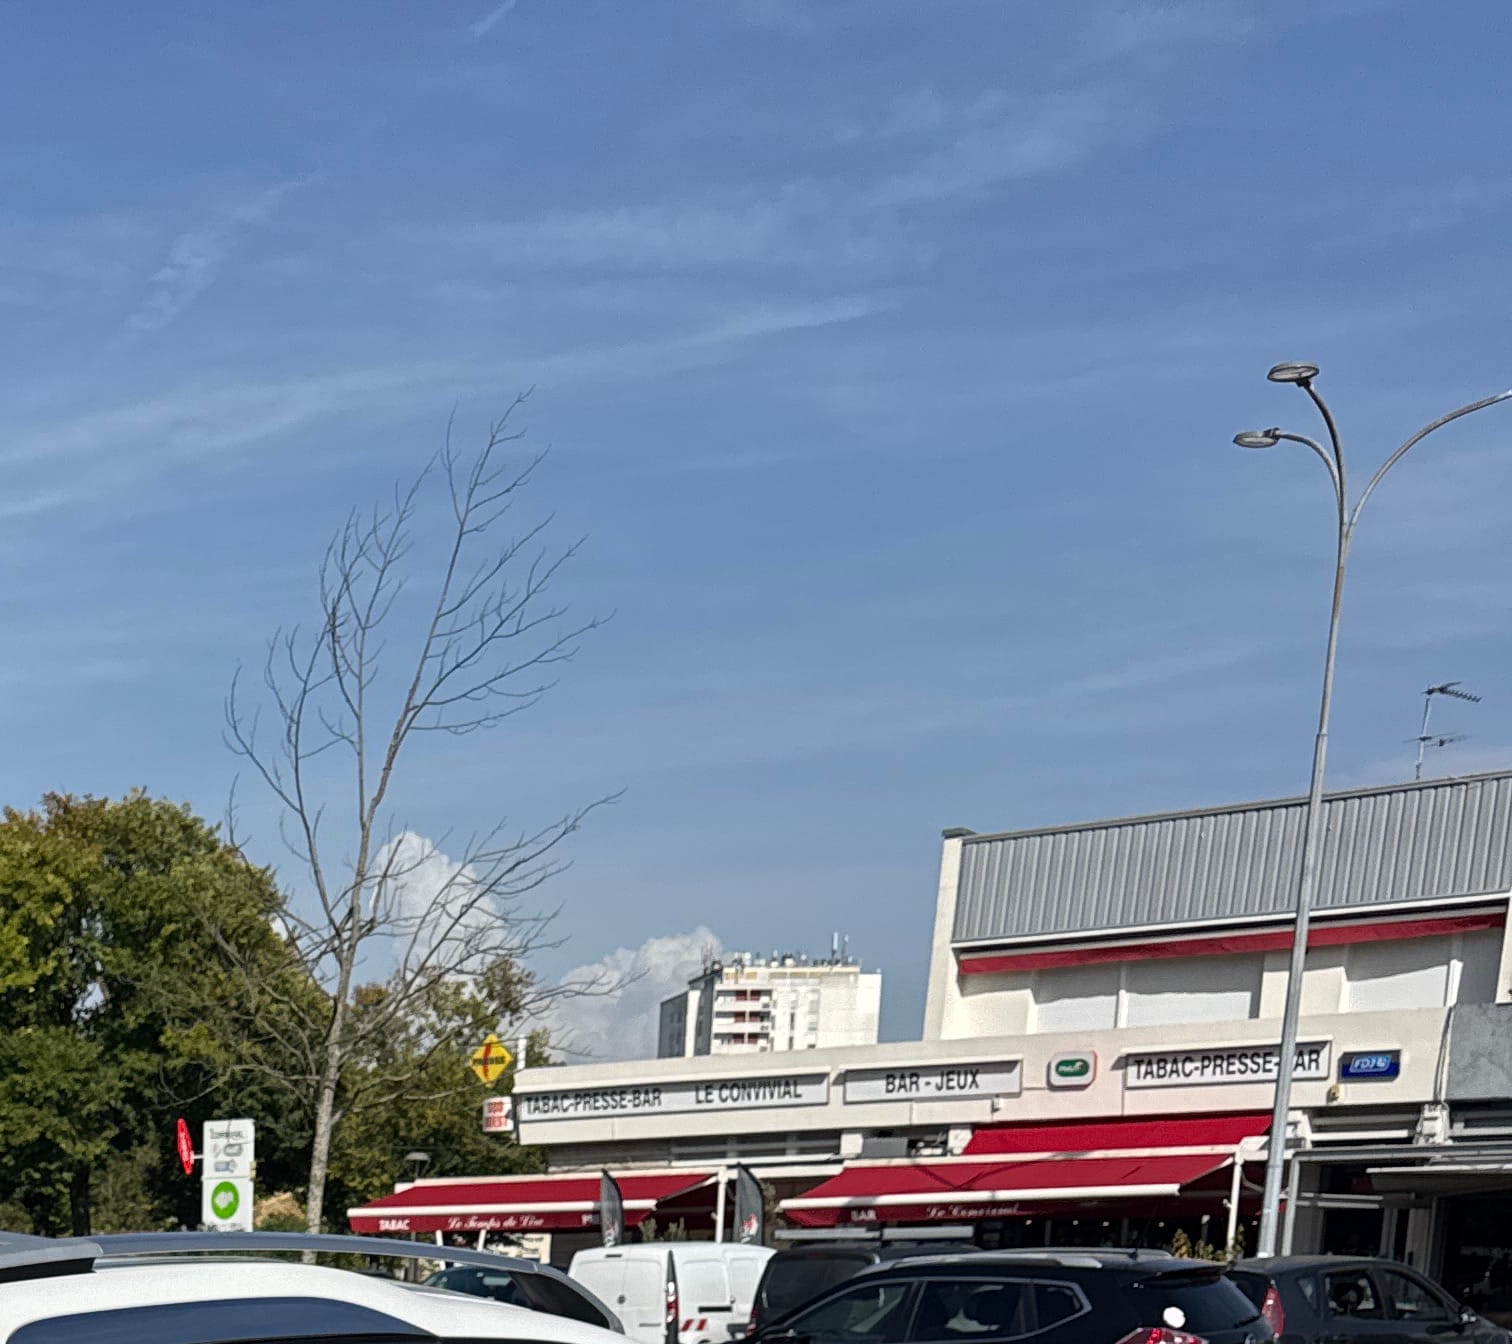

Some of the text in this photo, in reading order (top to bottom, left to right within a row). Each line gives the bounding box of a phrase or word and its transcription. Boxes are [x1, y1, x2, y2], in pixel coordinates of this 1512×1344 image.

[1135, 1050, 1320, 1081] TABAC-PRESSE-AR
[694, 1079, 803, 1104] LE CONVIVIAL
[885, 1073, 920, 1093] BAR
[935, 1069, 980, 1092] JEUX
[525, 1087, 663, 1115] TABAC-PRESSE-BAR
[378, 1218, 410, 1231] TABAC
[850, 1209, 877, 1222] BAR
